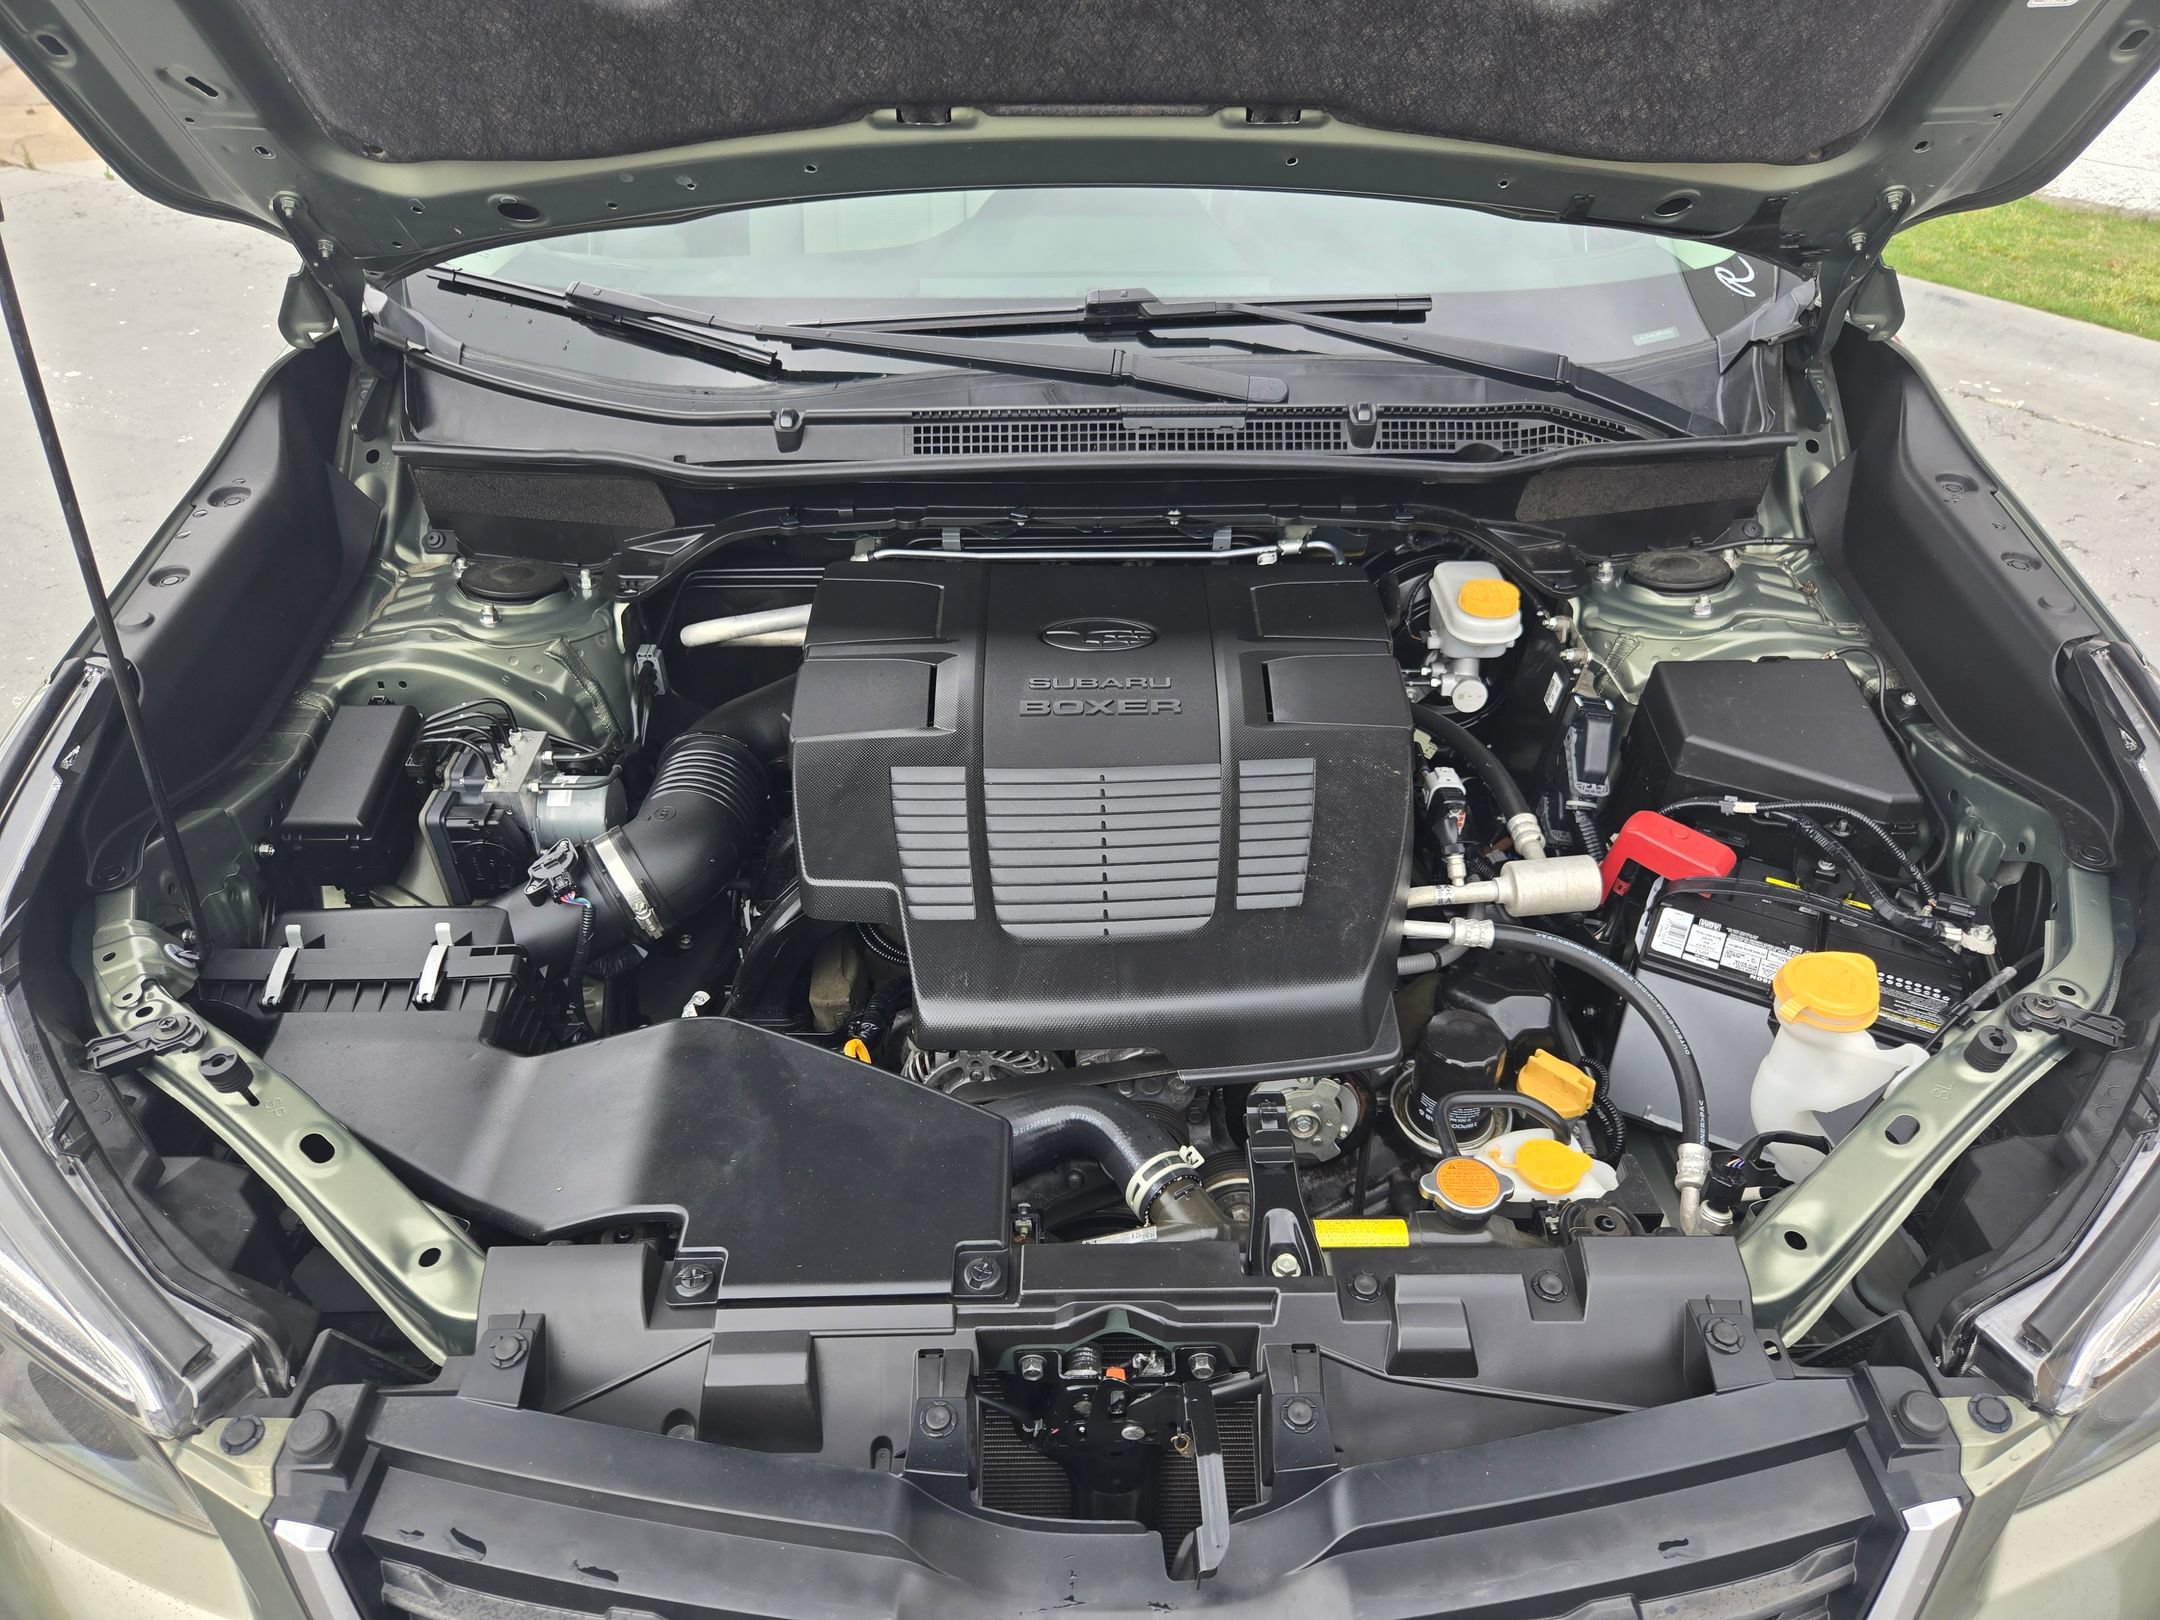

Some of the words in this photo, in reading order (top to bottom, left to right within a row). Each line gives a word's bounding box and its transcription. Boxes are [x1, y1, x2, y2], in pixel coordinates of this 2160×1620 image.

[1714, 255, 1756, 298] R
[1028, 676, 1172, 690] SUBARU
[1019, 698, 1182, 718] BOXER
[1749, 973, 1772, 984] ISON
